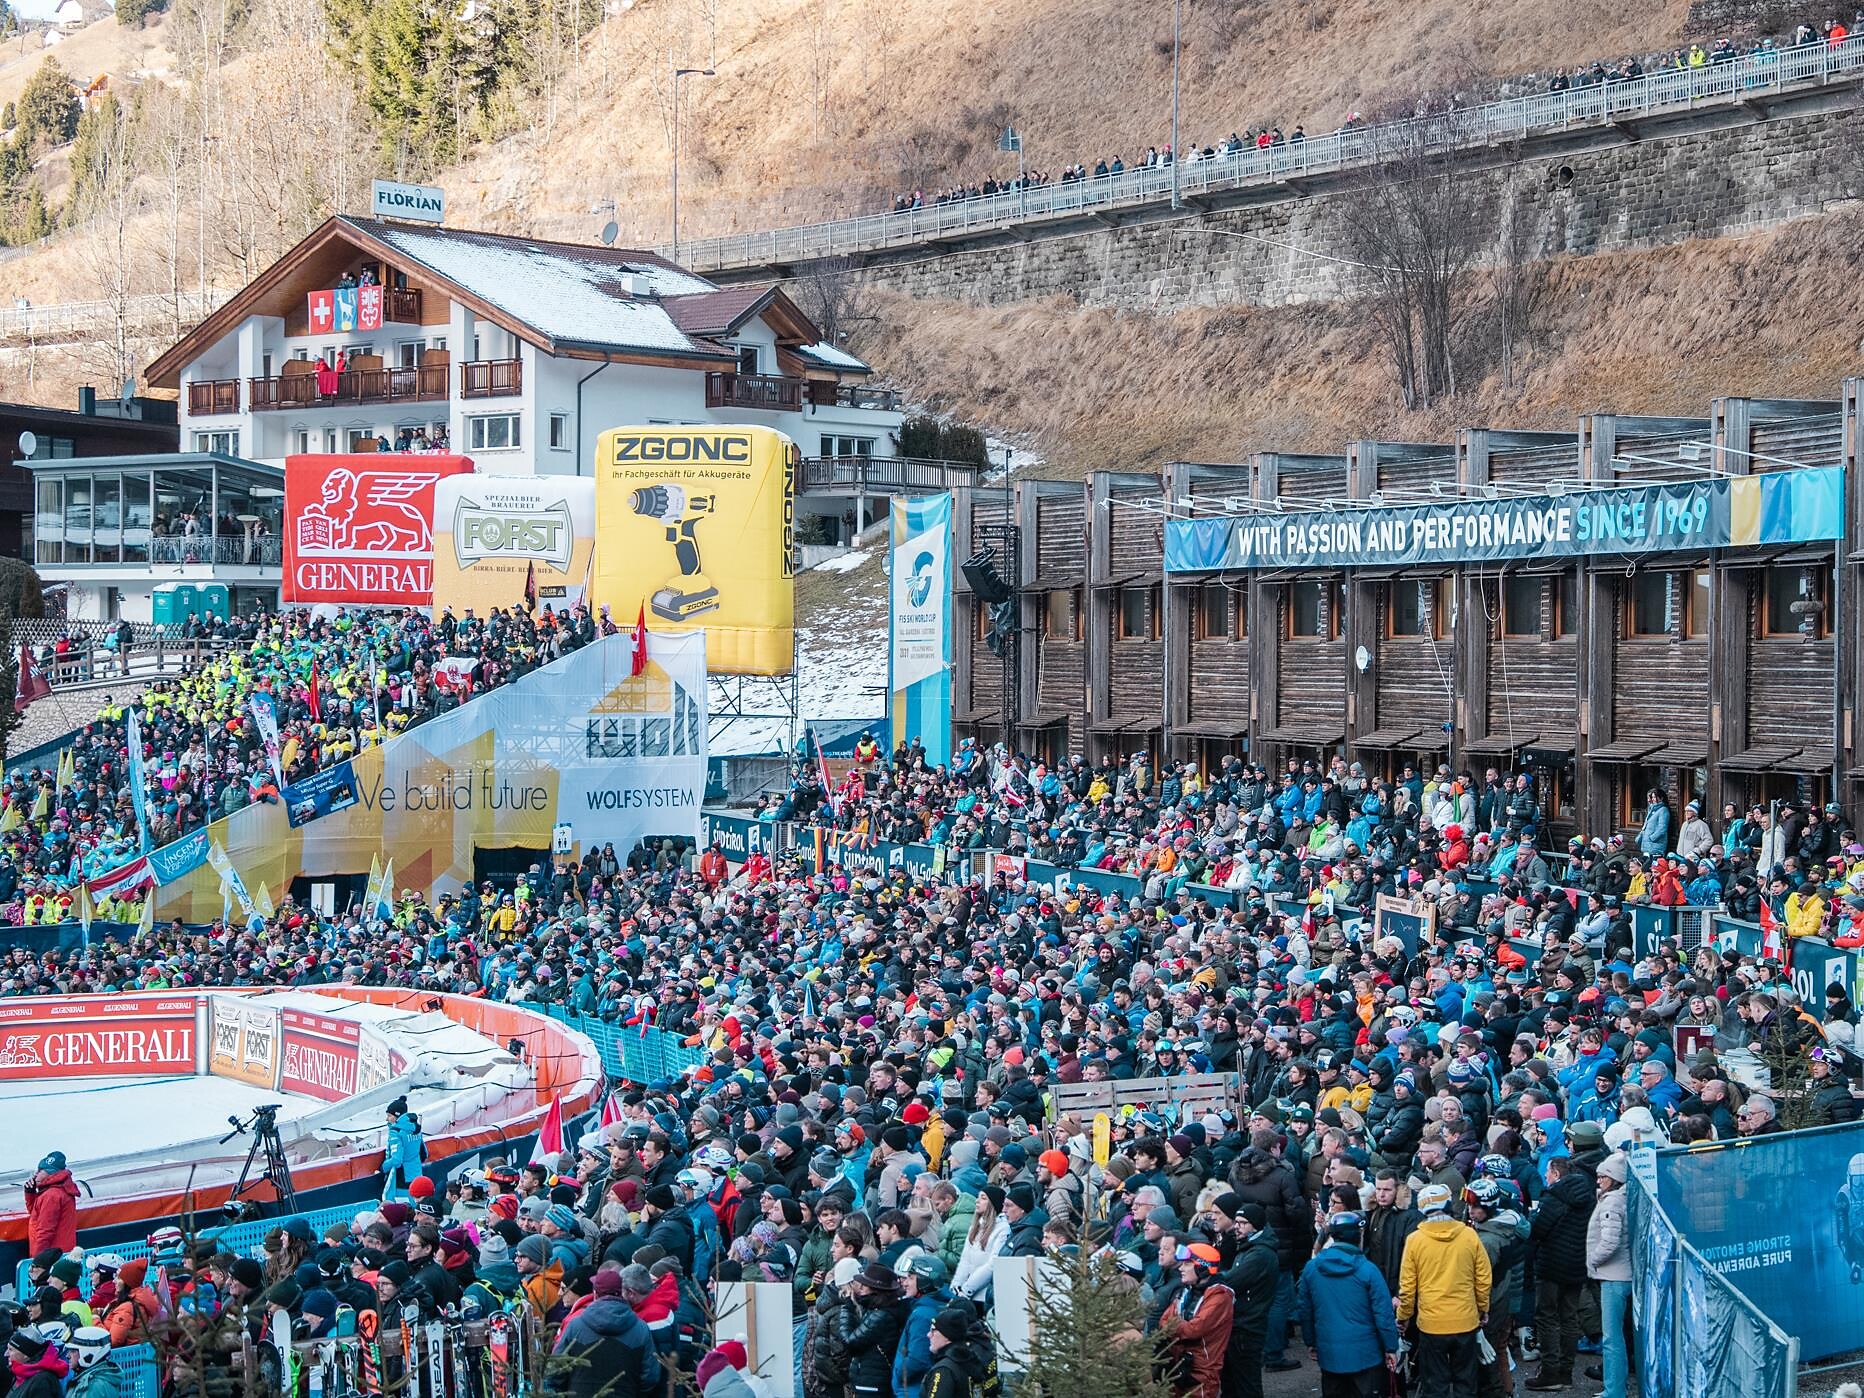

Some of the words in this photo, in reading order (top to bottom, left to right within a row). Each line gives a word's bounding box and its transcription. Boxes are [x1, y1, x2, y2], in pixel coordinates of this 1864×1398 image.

[378, 191, 442, 212] FLORIAN
[616, 437, 749, 462] ZGONC
[613, 471, 623, 479] Ihr
[625, 470, 681, 480] Fachgeschäft
[683, 470, 695, 478] für
[698, 470, 751, 480] Akkugeräte
[783, 444, 794, 575] ZGONC
[464, 517, 563, 552] FORST
[1238, 526, 1281, 556] WITH
[1286, 521, 1362, 555] PASSION
[1366, 519, 1407, 551] AND
[1412, 507, 1571, 550] PERFORMANCE
[1576, 500, 1647, 542] SINCE
[1655, 496, 1708, 536] 1969
[297, 562, 434, 593] GENERAL
[686, 598, 713, 611] ZGONC
[406, 769, 472, 811] build
[482, 768, 548, 811] future
[586, 788, 695, 810] WOLFSYSTEM
[153, 841, 198, 870] VINCENT
[796, 841, 816, 861] Garde
[43, 1028, 191, 1066] GENERALI
[300, 1046, 356, 1096] GENERALI
